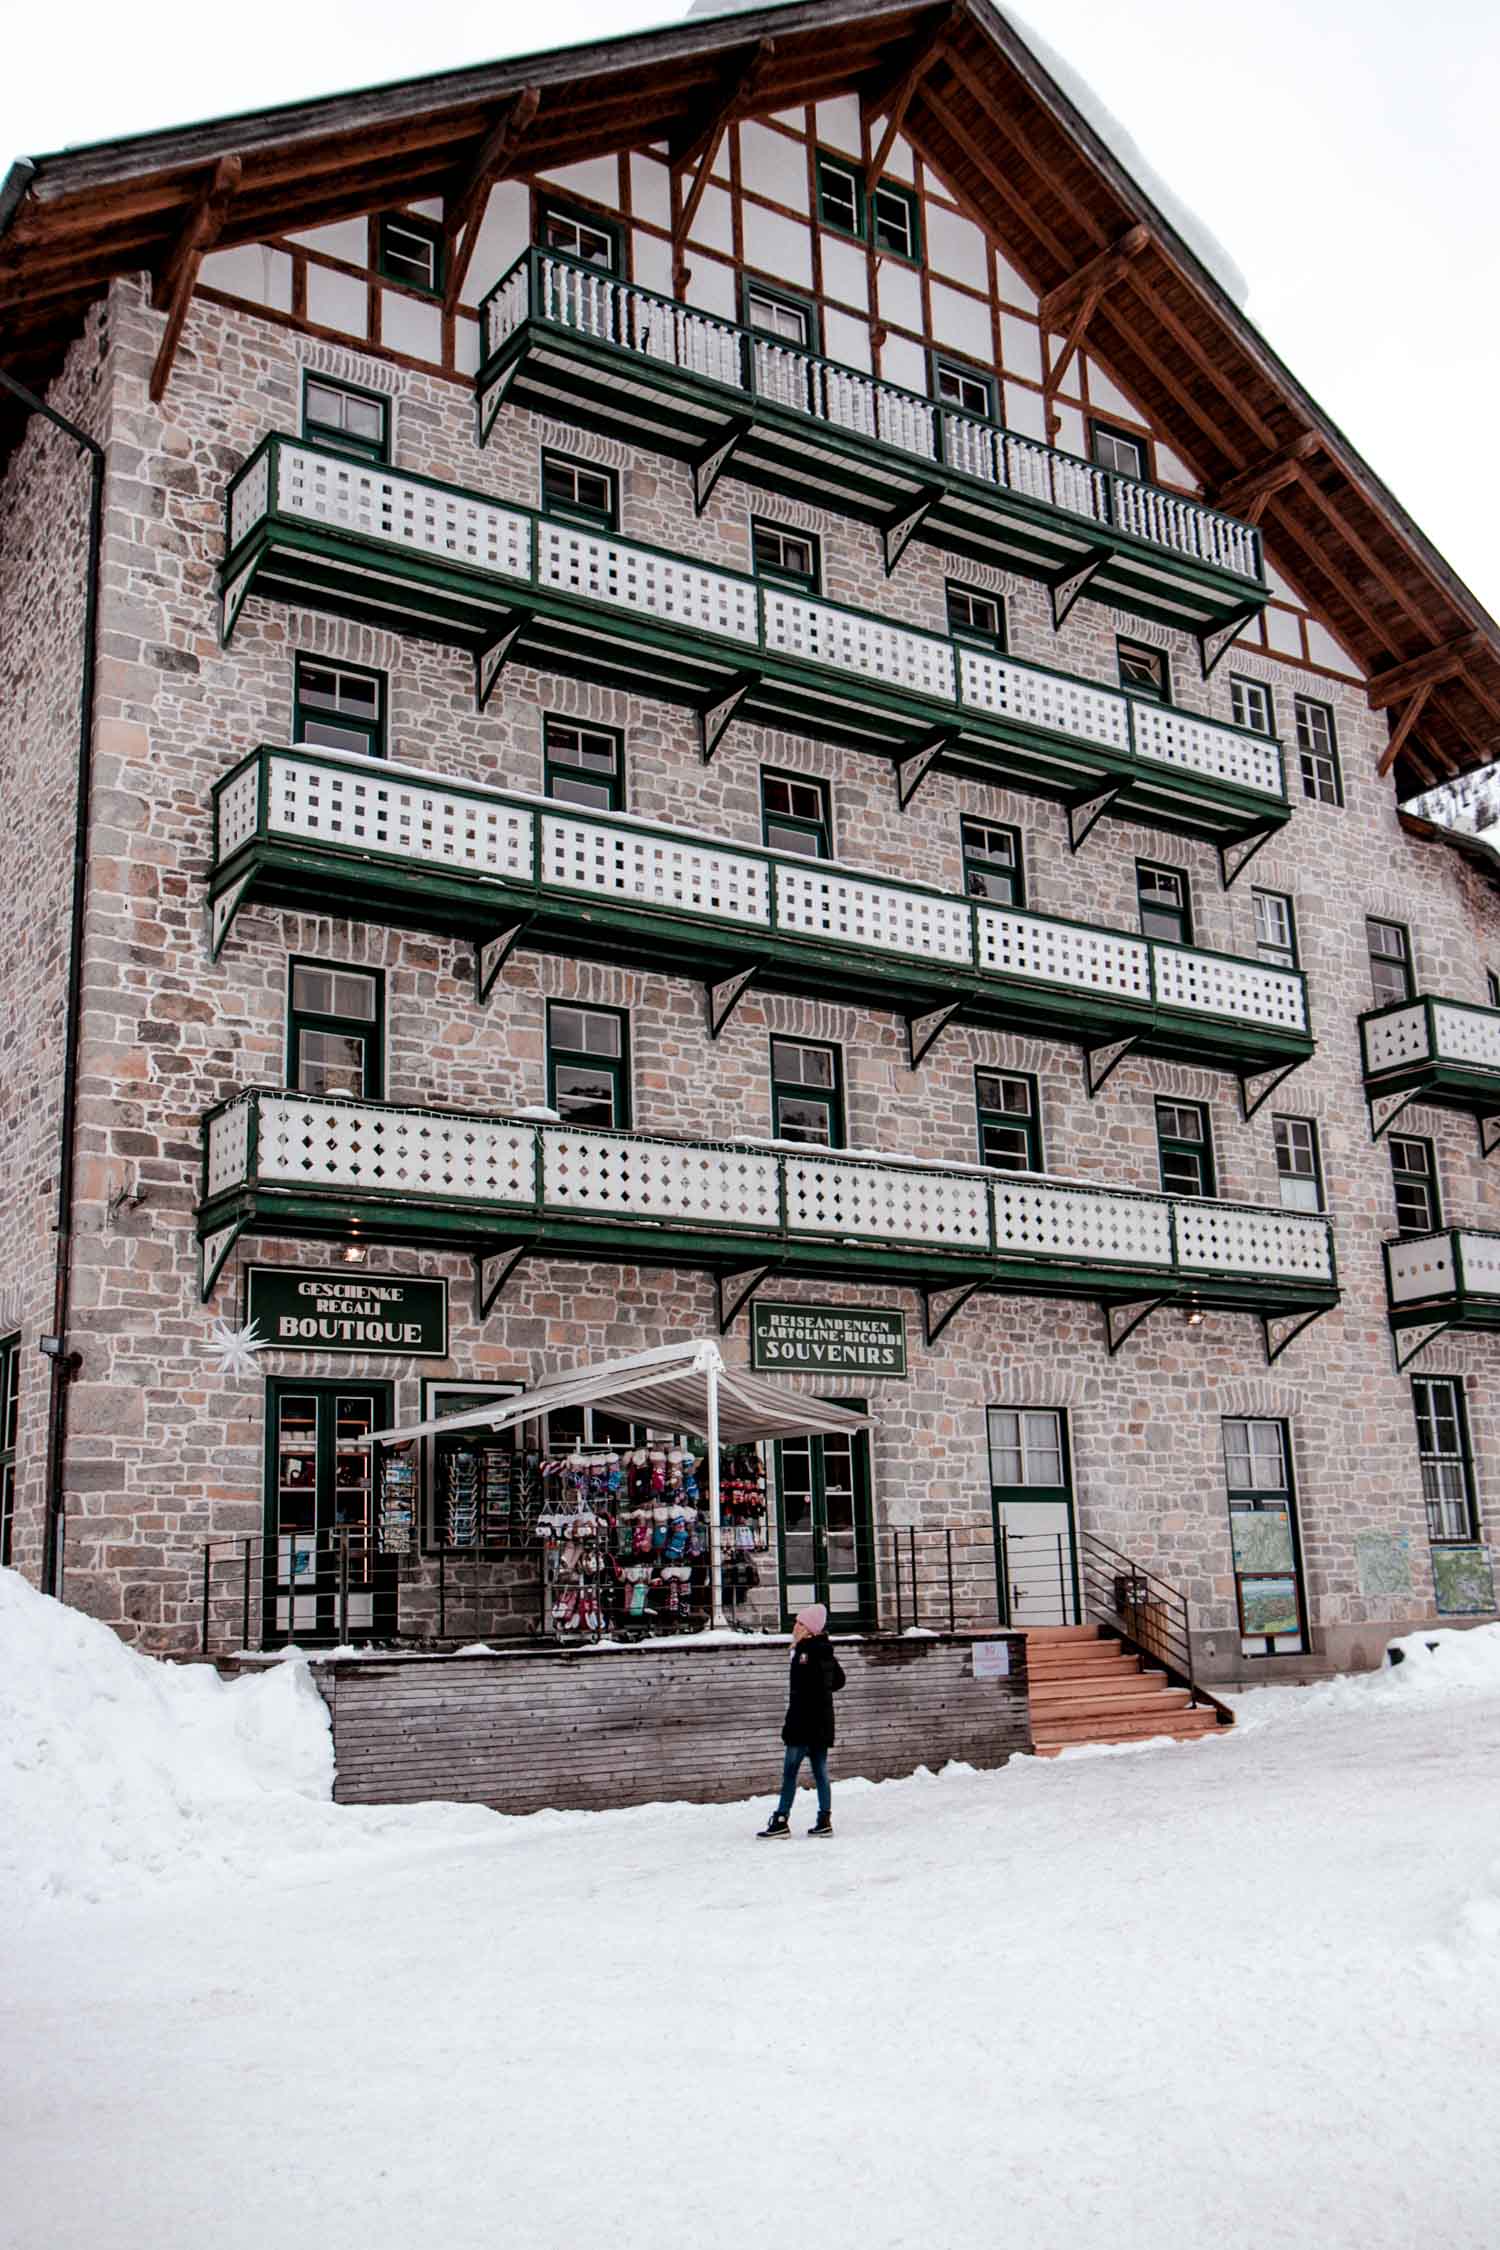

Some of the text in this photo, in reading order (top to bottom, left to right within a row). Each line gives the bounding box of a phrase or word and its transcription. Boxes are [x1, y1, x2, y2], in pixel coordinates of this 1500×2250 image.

[298, 1282, 403, 1301] GESCHENKE
[316, 1299, 381, 1315] REGALI
[279, 1316, 422, 1343] BOUTIQUE
[770, 1314, 888, 1332] REISEANDENKEN
[758, 1327, 902, 1345] CARTOLINE RICORDI
[766, 1341, 895, 1364] SOUVENIRS
